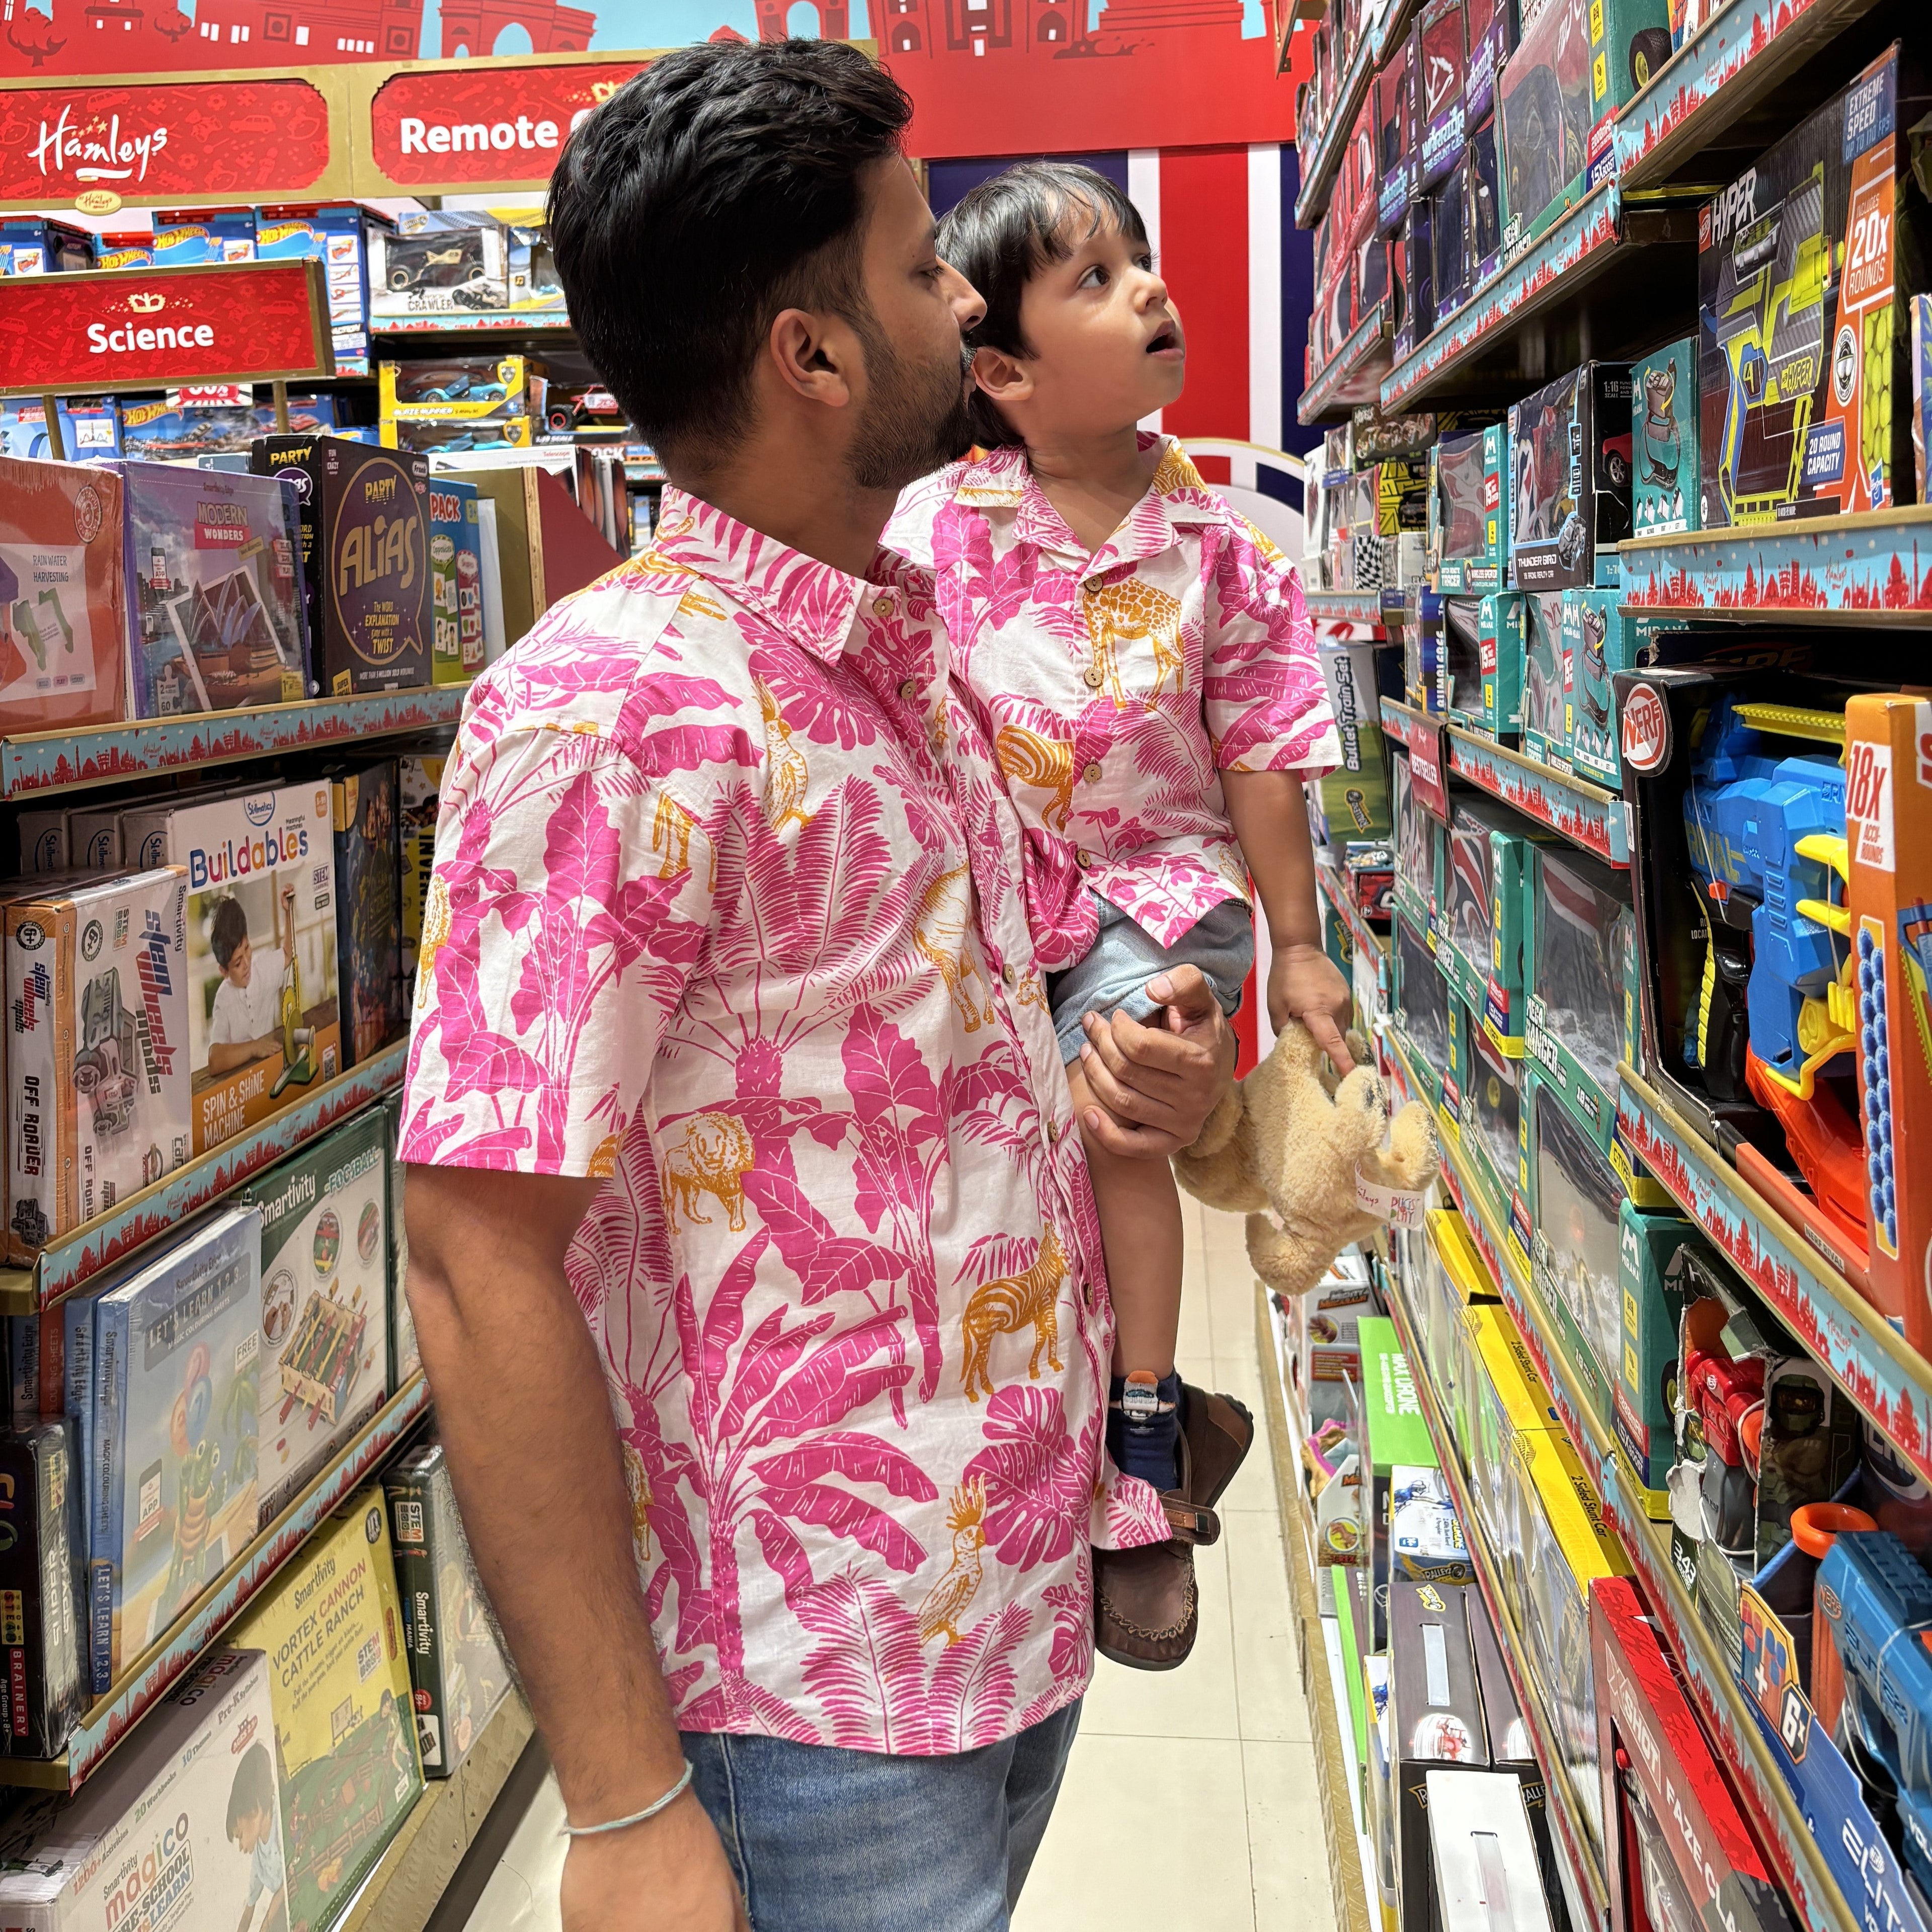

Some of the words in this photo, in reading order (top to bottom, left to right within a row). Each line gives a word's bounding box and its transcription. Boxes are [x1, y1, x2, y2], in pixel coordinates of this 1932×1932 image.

[1849, 72, 1884, 115] EXTREME
[401, 116, 558, 153] Remote
[1845, 141, 1857, 161] UP
[1857, 136, 1865, 154] TO
[1878, 115, 1890, 140] FPS
[1847, 103, 1876, 141] SPEED
[28, 103, 168, 182] Hamleys
[1603, 157, 1615, 177] BOOST
[1711, 167, 1757, 249] HYPER
[1856, 193, 1880, 218] INCLUDES
[1848, 258, 1885, 297] ROUNDS
[87, 323, 214, 353] Science
[1603, 381, 1619, 393] 1:16
[1786, 357, 1812, 393] HYPER
[270, 446, 312, 465] PARTY
[1809, 439, 1818, 453] 20
[1819, 431, 1841, 451] ROUND
[1807, 451, 1841, 476] CAPACITY
[365, 474, 396, 505] PARTY
[430, 493, 460, 522] PACK
[197, 501, 249, 527] MODERN
[204, 528, 244, 541] WONDERS
[33, 555, 47, 566] RAIN
[48, 555, 67, 567] WATER
[34, 572, 69, 583] HARVESTING
[1518, 555, 1542, 569] THUNDER
[365, 614, 399, 626] EXPLANATION
[373, 638, 394, 654] TWIST
[1335, 657, 1352, 684] Set
[1341, 686, 1355, 725] Train
[1623, 699, 1661, 753] NERF
[1342, 723, 1360, 771] Bullet
[1411, 752, 1438, 787] BESTSELLER
[1846, 745, 1887, 821] 18X
[1864, 824, 1881, 842] ACCU-
[190, 827, 308, 889] Buildables
[1860, 843, 1884, 864] ROUNDS
[313, 866, 329, 884] STEM
[175, 885, 186, 952] Smartivity
[1526, 996, 1543, 1030] MEGA
[1525, 1017, 1558, 1079] RANGER
[24, 1076, 39, 1107] OFF
[203, 1093, 226, 1123] SPIN
[228, 1086, 237, 1104] &
[239, 1070, 265, 1104] SHINE
[24, 1113, 39, 1176] ROADER
[204, 1106, 245, 1149] MACHINE
[85, 1146, 93, 1172] OFF
[259, 1173, 316, 1229] Smartivity
[1805, 1224, 1823, 1250] NERF
[1823, 1245, 1844, 1272] RIVAL
[1621, 1252, 1640, 1283] MIRANA
[149, 1311, 178, 1348] LET'S
[183, 1285, 213, 1323] LEARN
[168, 1332, 184, 1349] MAGIC
[185, 1310, 213, 1334] COLOURING
[214, 1298, 230, 1314] SHEETS
[23, 1325, 36, 1349] Edge
[75, 1327, 88, 1378] Smartivity
[237, 1333, 257, 1357] FREE
[21, 1349, 35, 1400] Smartivity
[1392, 1353, 1411, 1374] MAX
[1513, 1346, 1525, 1362] Sided
[1520, 1358, 1532, 1374] Stunt
[1394, 1377, 1421, 1416] DRONE
[1629, 1444, 1644, 1477] BOOST
[102, 1464, 110, 1505] COLOURING
[142, 1498, 158, 1520] APP
[411, 1505, 422, 1540] STEM
[1574, 1482, 1589, 1506] Sided
[1584, 1501, 1600, 1524] Stunt
[1593, 1520, 1607, 1538] Car
[1673, 1539, 1697, 1584] 343
[98, 1567, 110, 1603] LET'S
[294, 1558, 336, 1609] Smartivity
[1820, 1587, 1842, 1610] NERF
[97, 1607, 109, 1645] LEARN
[273, 1611, 317, 1670] VORTEX
[319, 1559, 366, 1618] CANNON
[415, 1591, 433, 1656] Smartivity
[282, 1629, 324, 1688] CATTLE
[326, 1585, 364, 1638] RANCH
[358, 1631, 380, 1664] STEM
[13, 1650, 26, 1734] BRAINERY
[217, 1691, 239, 1725] Pre-K
[182, 1749, 192, 1767] 10
[134, 1801, 147, 1824] 20
[1666, 1776, 1702, 1867] FAZE
[73, 1857, 101, 1896] 1200+
[102, 1828, 129, 1863] Activities
[103, 1850, 138, 1901] Smartivity
[106, 1812, 189, 1931] magico
[149, 1864, 191, 1928] LEARN
